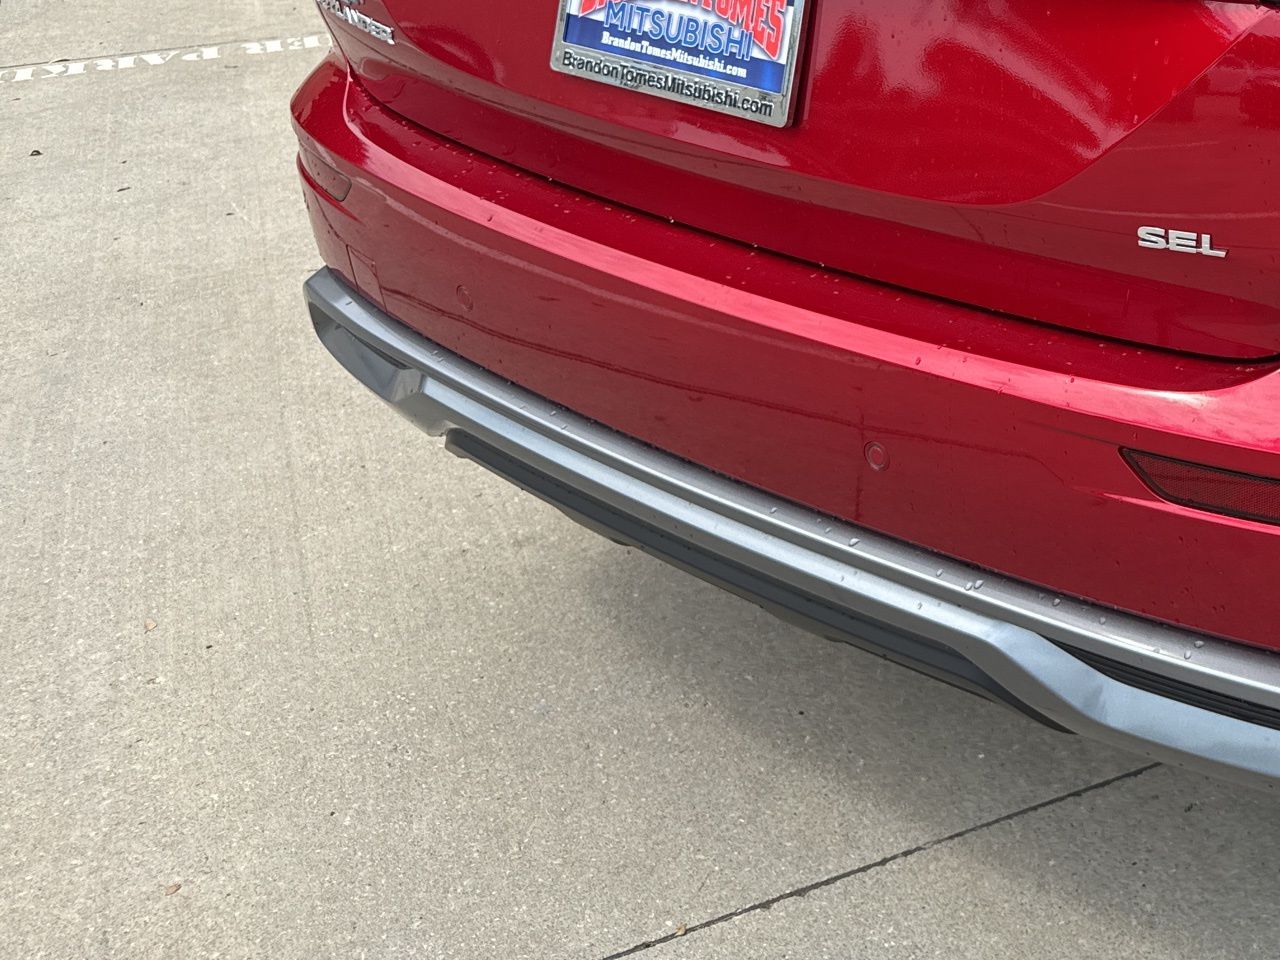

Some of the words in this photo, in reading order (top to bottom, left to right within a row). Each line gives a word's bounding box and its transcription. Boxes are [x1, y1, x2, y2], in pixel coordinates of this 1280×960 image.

[601, 32, 747, 78] BrandonTomesMitsubishi.com
[603, 0, 753, 60] MITSUBISHI
[562, 50, 773, 117] BrandonTomesMitsubishi.com
[1137, 225, 1227, 258] SEL
